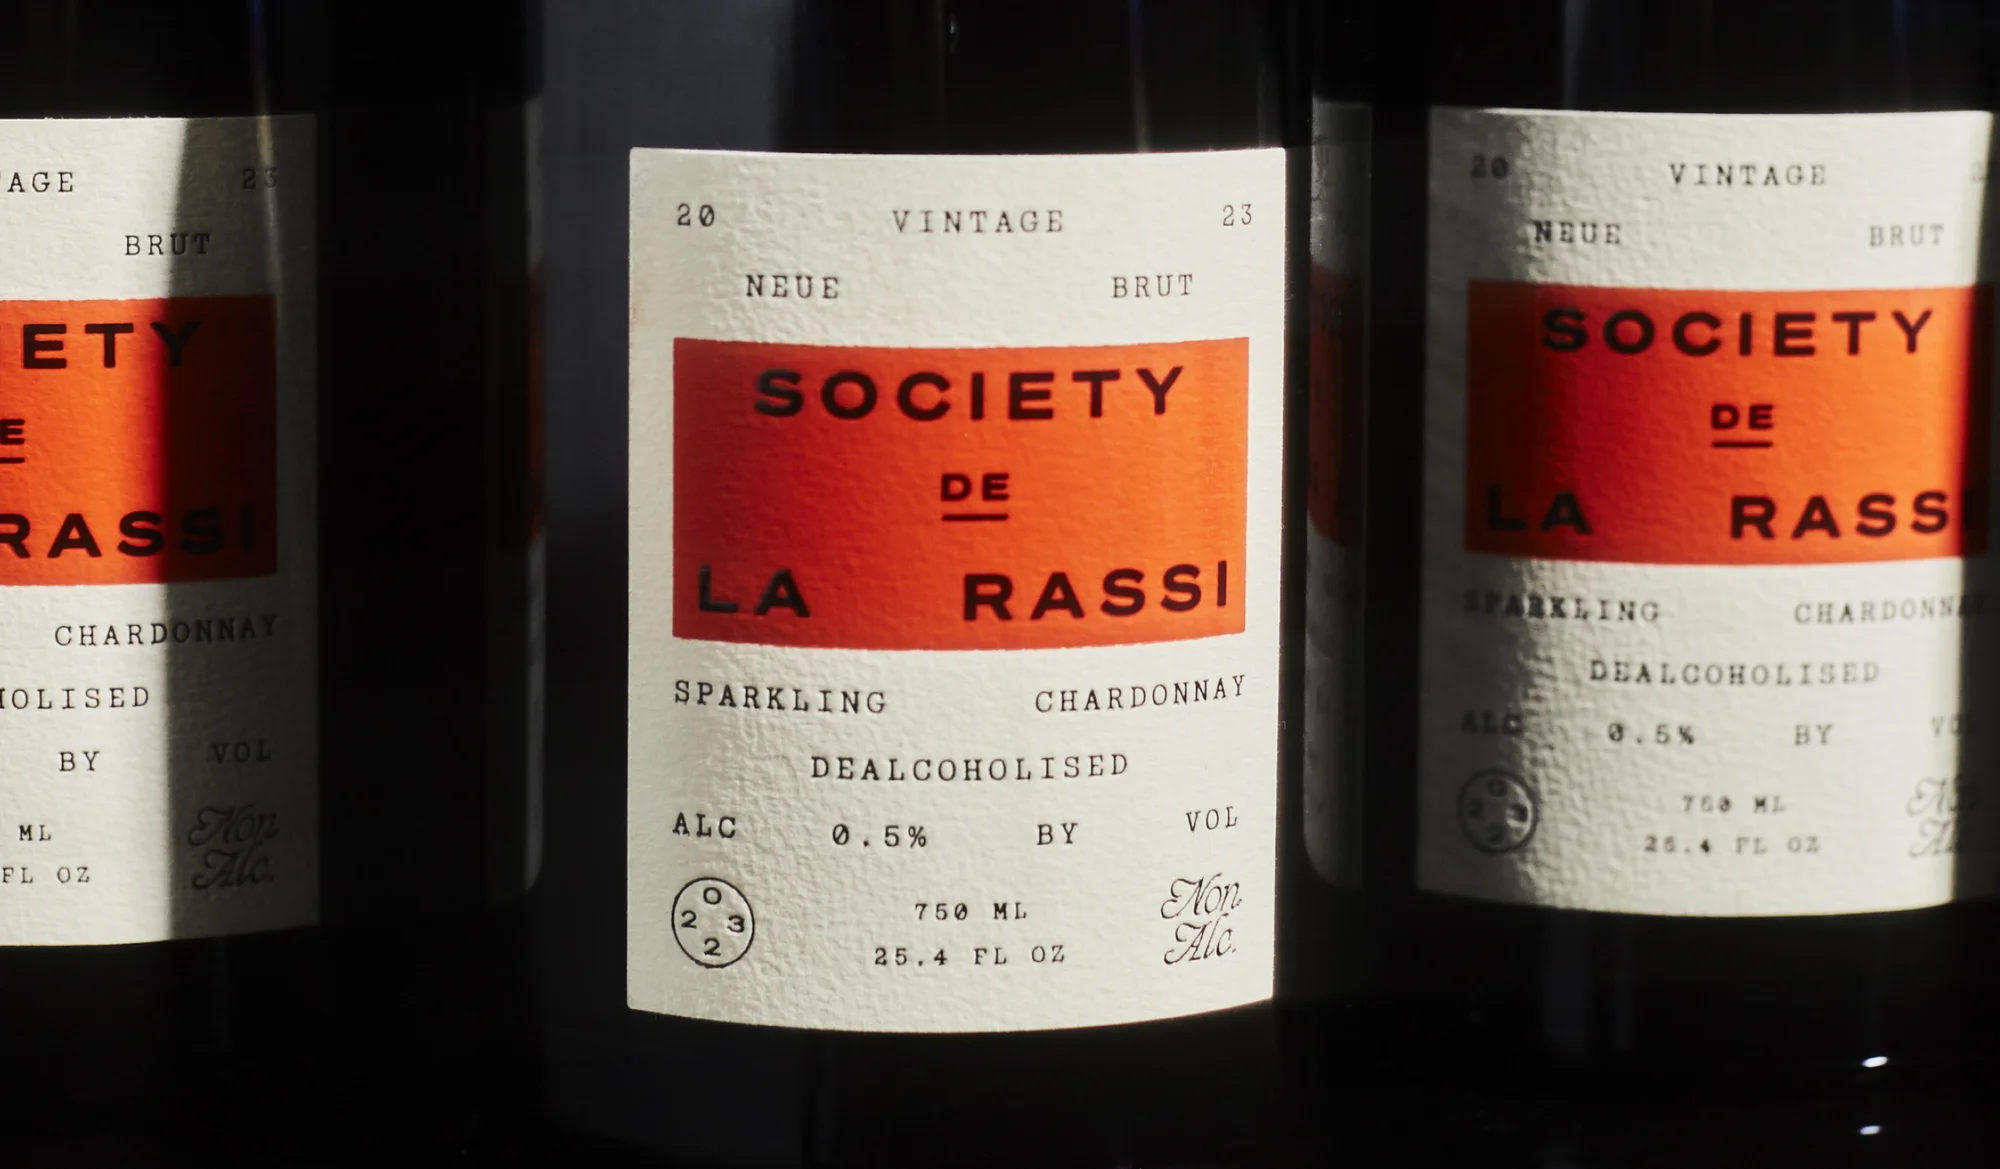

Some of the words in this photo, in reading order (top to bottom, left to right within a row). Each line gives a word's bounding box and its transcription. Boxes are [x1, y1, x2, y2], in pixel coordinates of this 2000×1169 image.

[0, 171, 73, 193] AGE
[242, 167, 277, 190] 23
[1669, 163, 1827, 187] VINTAGE
[676, 202, 716, 227] 20
[892, 209, 1064, 234] VINTAGE
[1222, 203, 1252, 227] 23
[125, 232, 211, 256] BRUT
[1533, 221, 1622, 245] NEUE
[1869, 223, 1946, 248] BRUT
[745, 274, 840, 299] NEUE
[1111, 273, 1194, 299] BRUT
[23, 321, 201, 369] ETY
[1542, 307, 1933, 356] SOCIETY
[753, 365, 1184, 422] SOCIETY
[1711, 404, 1774, 429] DE
[941, 472, 1010, 501] DE
[1486, 485, 1593, 535] LA
[0, 509, 254, 558] RASSI
[697, 564, 811, 618] LA
[963, 559, 1228, 622] RASSI
[1463, 589, 1660, 622] SPARKLING
[54, 612, 279, 647] CHARDONNAY
[1590, 659, 1880, 686] DEALCOHOLISED
[674, 679, 887, 714] SPARKLING
[1034, 674, 1246, 713] CHARDONNAY
[1460, 708, 1522, 736] ALC
[1607, 722, 1695, 746] 0.5%
[1794, 723, 1833, 746] BY
[59, 750, 100, 772] BY
[211, 740, 273, 765] VOL
[810, 752, 1129, 782] DEALCOHOLISED
[19, 824, 52, 842] ML
[672, 811, 737, 839] ALC
[831, 823, 928, 848] 0.5%
[1036, 822, 1078, 846] BY
[1185, 806, 1238, 833] VOL
[2, 866, 34, 884] FL
[57, 865, 91, 884] OZ
[914, 902, 969, 921] 750
[993, 901, 1028, 920] ML
[1163, 912, 1237, 966] Alc.
[874, 946, 948, 967] 25.4
[973, 946, 1008, 966] FL
[1030, 944, 1066, 964] OZ
